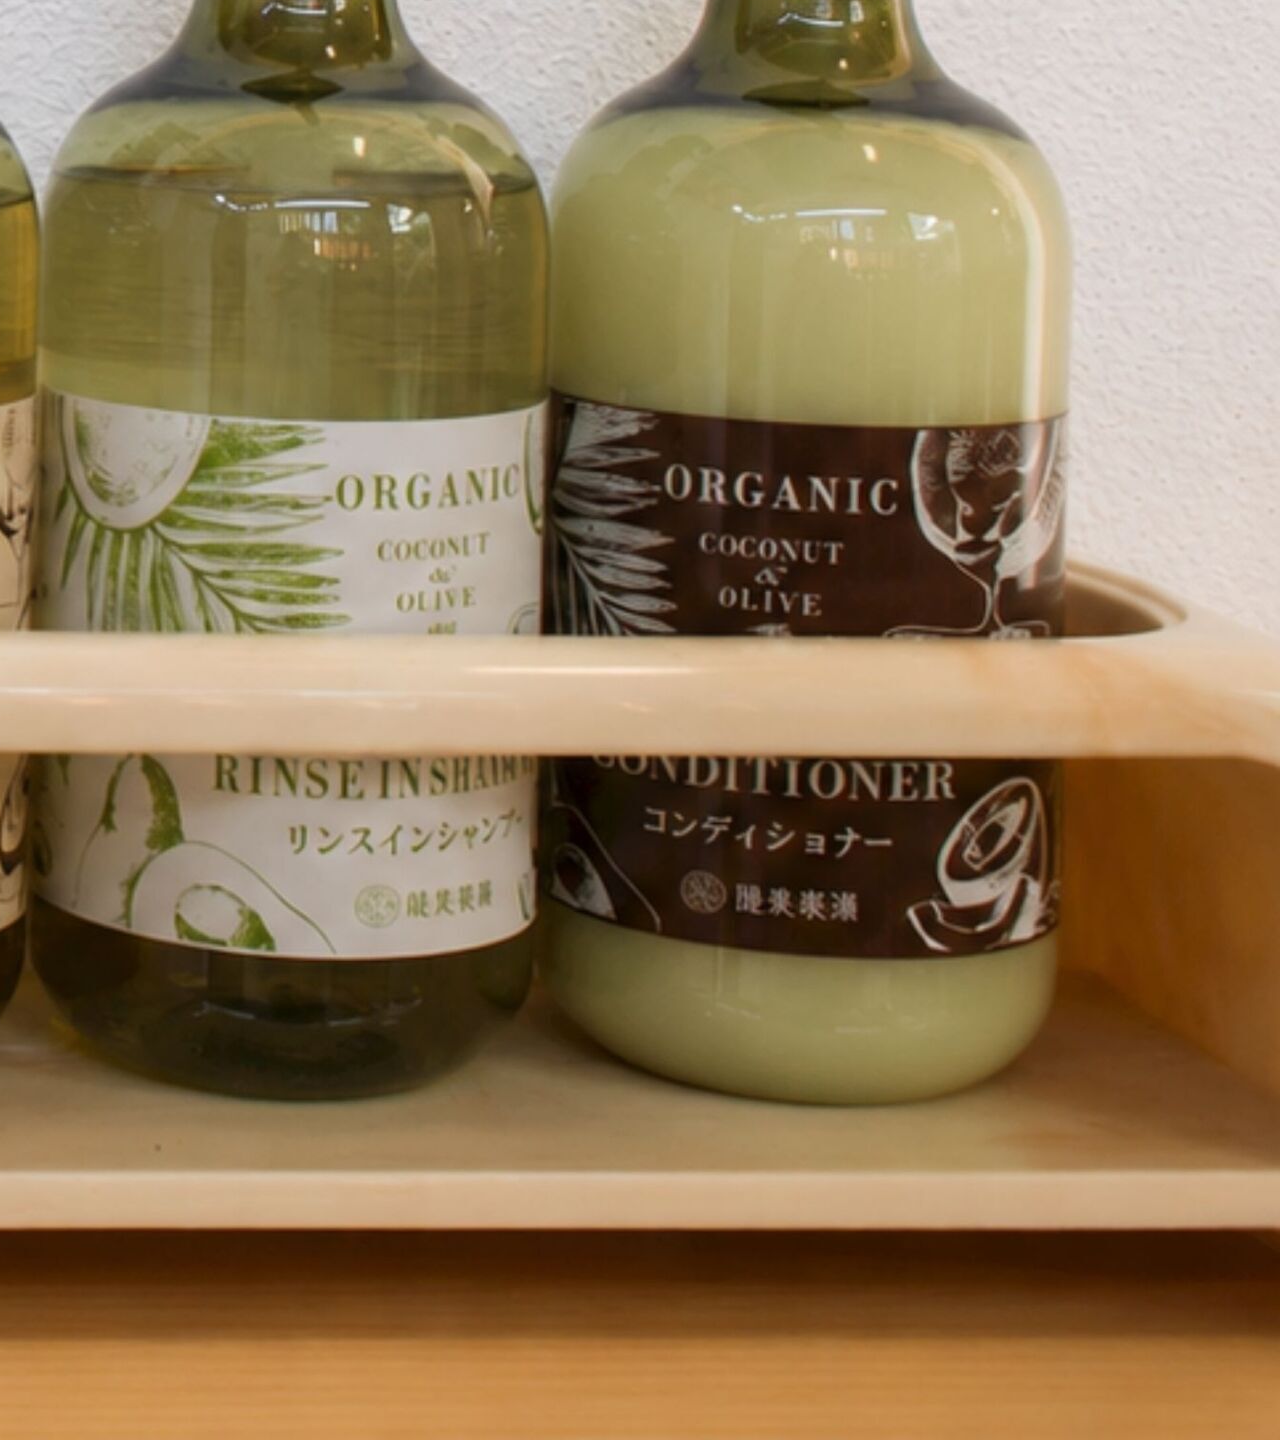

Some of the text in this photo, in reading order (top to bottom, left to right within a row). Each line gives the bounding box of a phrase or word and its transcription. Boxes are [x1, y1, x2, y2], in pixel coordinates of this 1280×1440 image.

[336, 464, 520, 512] ORGANIC
[663, 464, 899, 516] ORGANIC
[377, 531, 490, 561] COCONUT
[699, 532, 844, 565] COCONUT
[396, 586, 476, 613] OLIVE
[718, 586, 822, 616] OLIVE
[643, 806, 894, 858] コンディショナー
